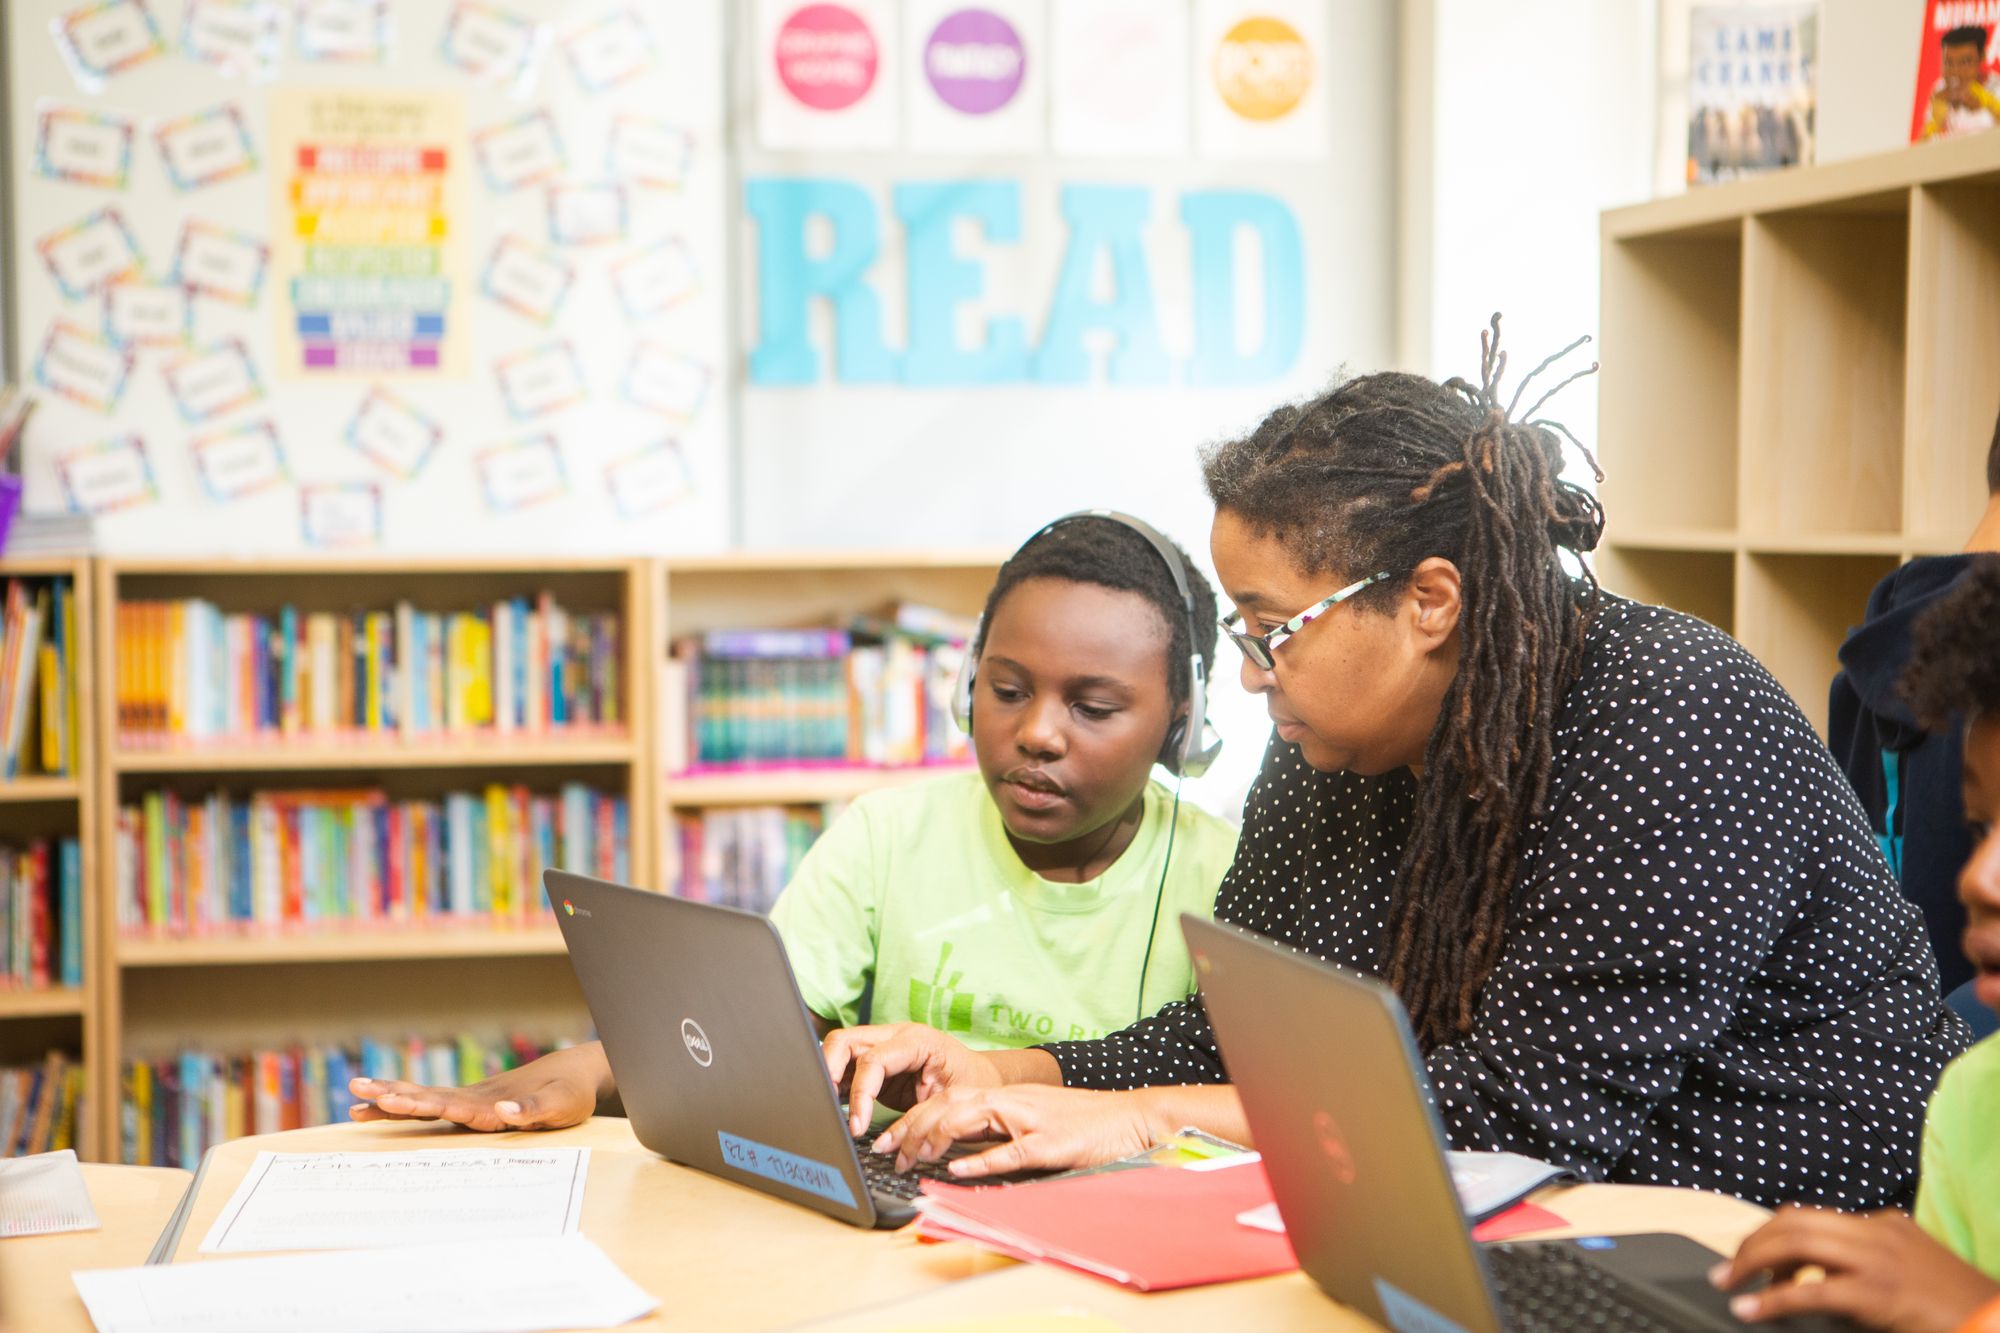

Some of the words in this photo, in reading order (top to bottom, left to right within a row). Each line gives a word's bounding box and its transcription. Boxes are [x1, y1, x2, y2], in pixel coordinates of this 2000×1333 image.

[745, 178, 1307, 387] READ
[989, 1003, 1053, 1035] TWO
[1068, 1023, 1108, 1041] RI
